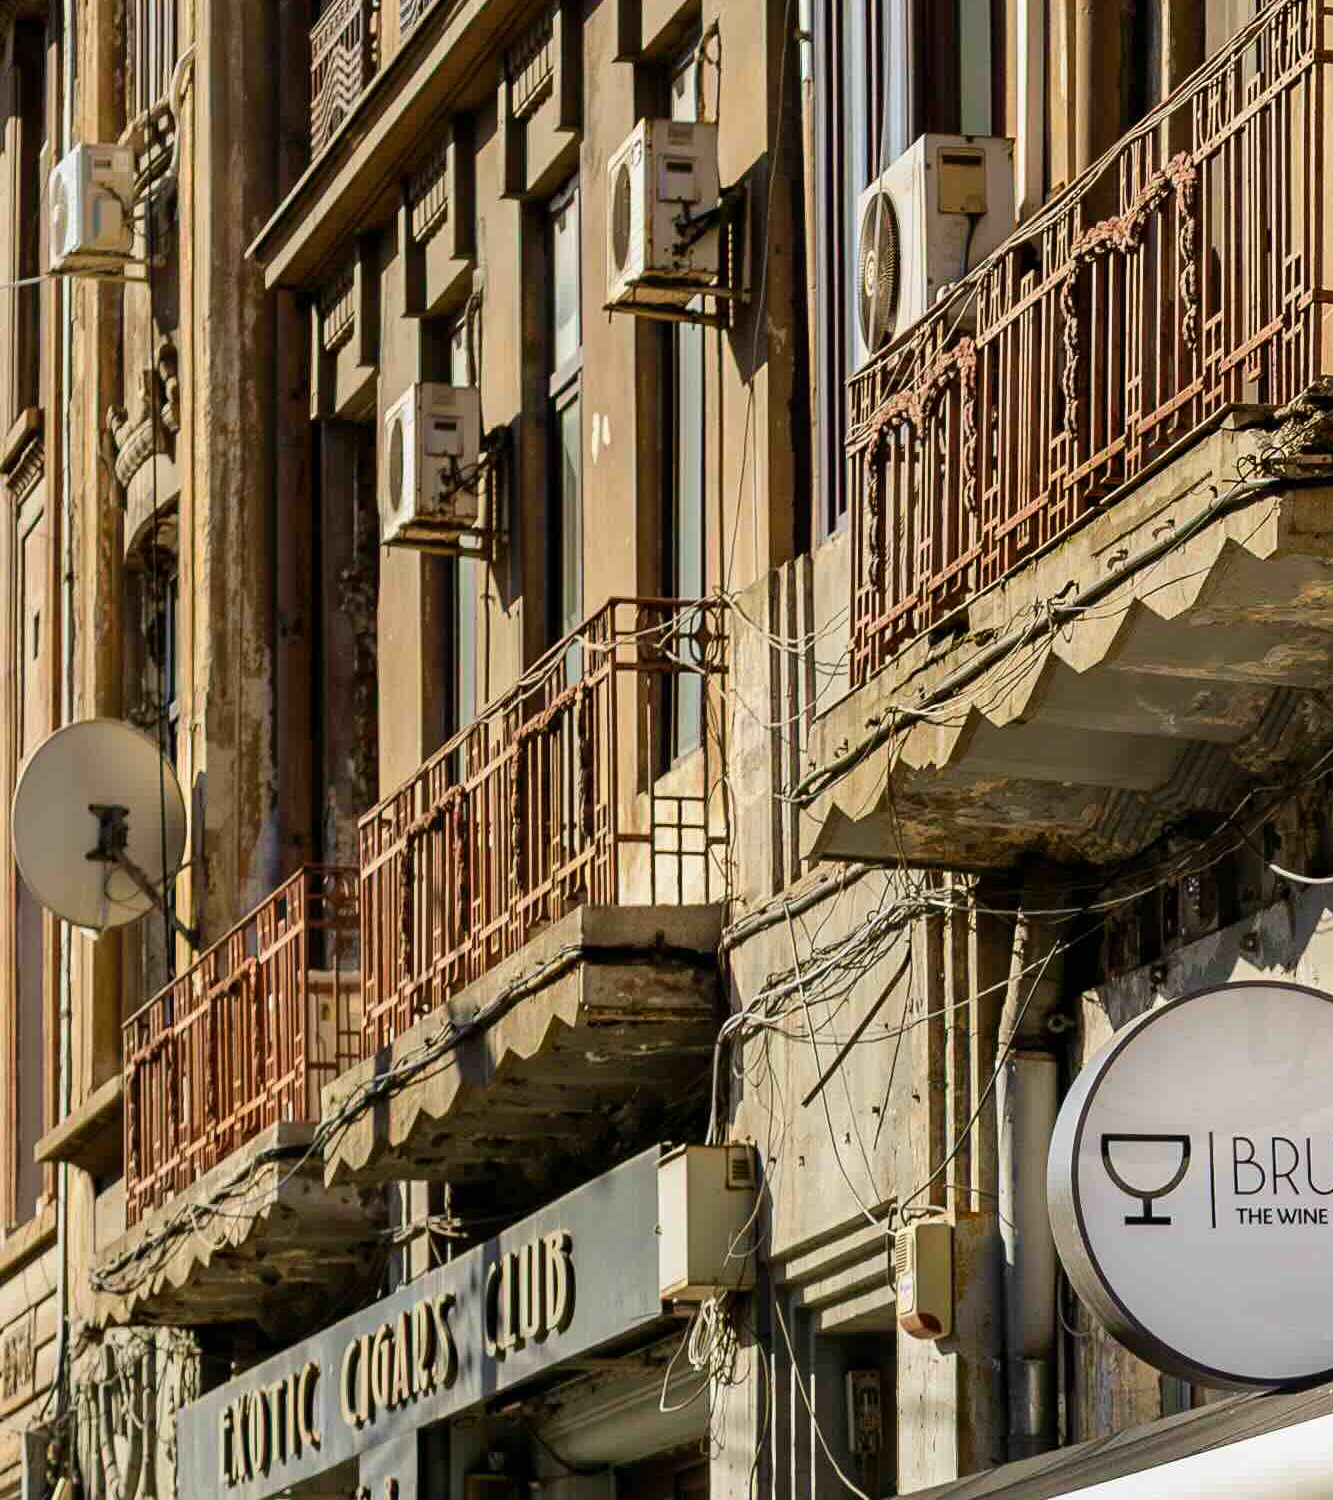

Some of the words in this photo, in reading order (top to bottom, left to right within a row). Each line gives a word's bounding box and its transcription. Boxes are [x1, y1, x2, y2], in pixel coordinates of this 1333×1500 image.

[1236, 1207, 1273, 1225] THE
[1276, 1207, 1329, 1225] WINE
[219, 1359, 321, 1485] EXOTIC
[340, 1293, 457, 1428] CIGARS
[484, 1230, 574, 1358] CLUB
